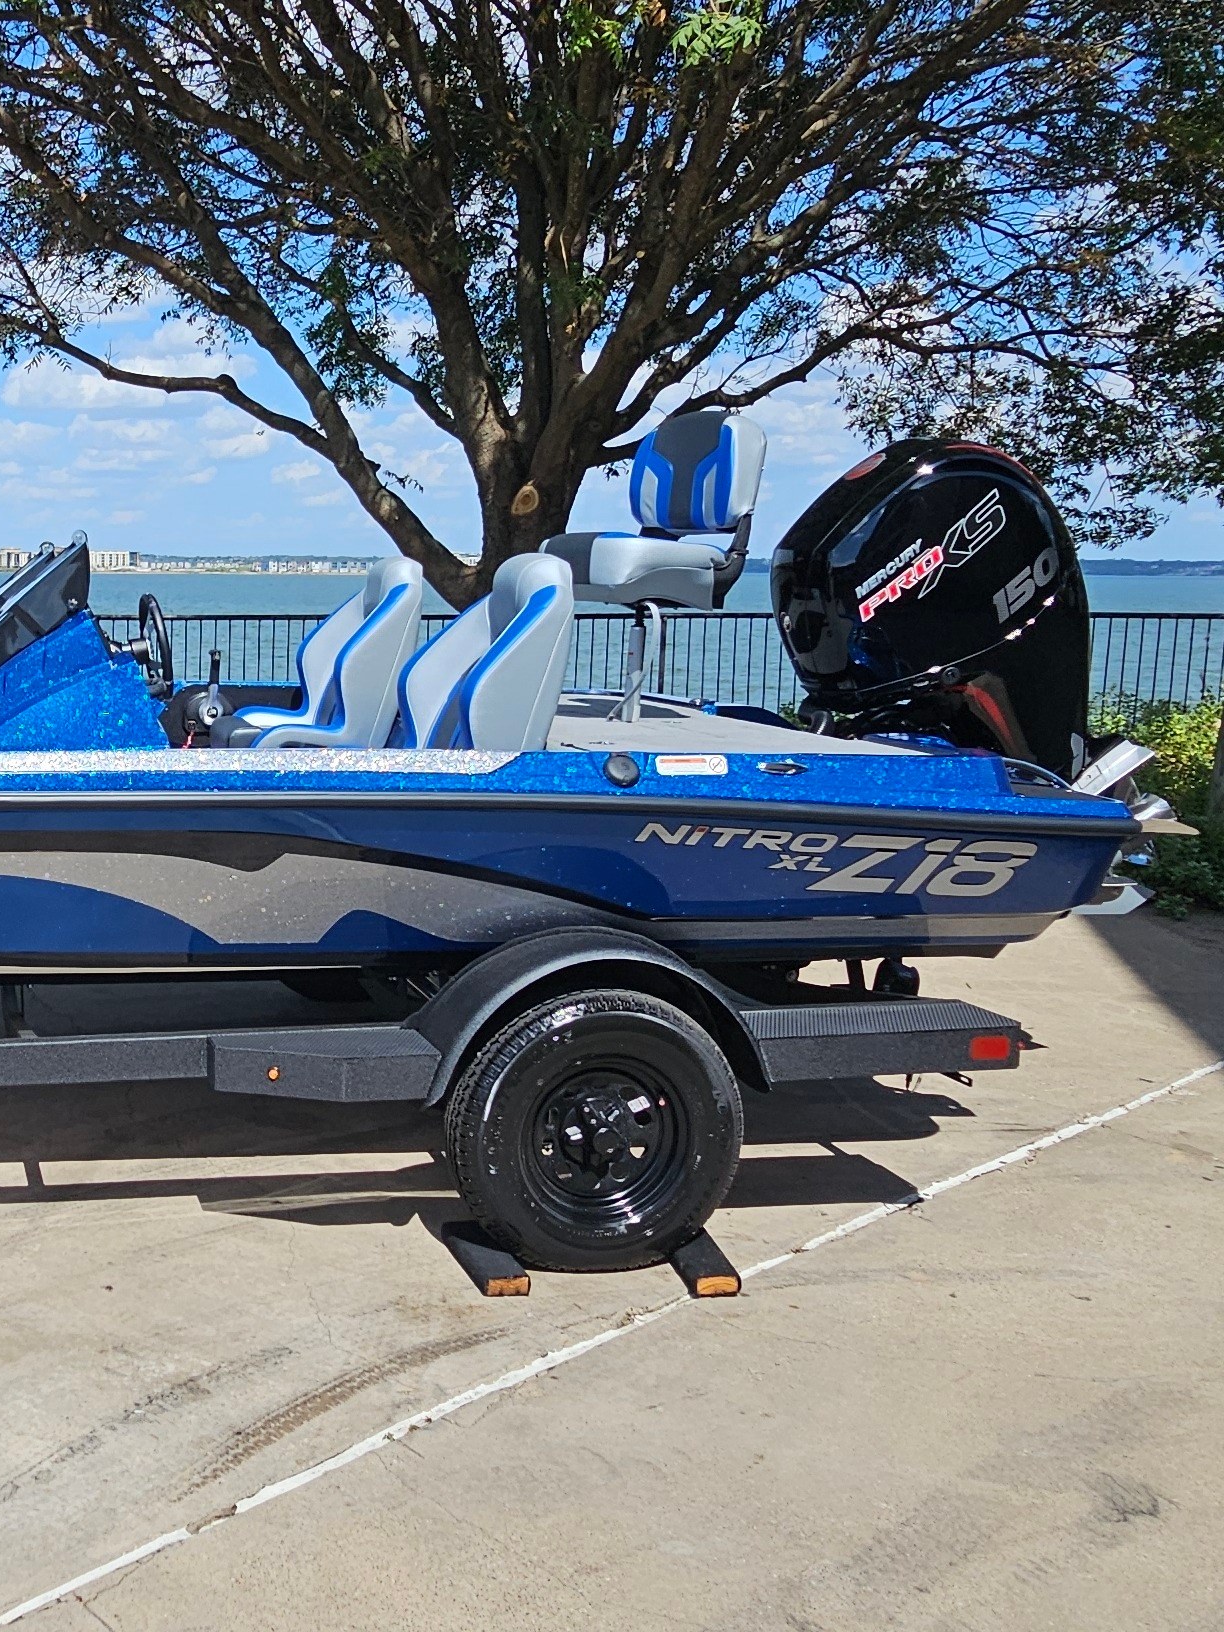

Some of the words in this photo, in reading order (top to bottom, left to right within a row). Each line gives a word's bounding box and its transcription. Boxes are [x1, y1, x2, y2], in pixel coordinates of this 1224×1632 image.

[855, 538, 923, 600] MERCURY
[992, 547, 1060, 624] 150
[634, 822, 840, 854] NITRO
[805, 834, 1039, 897] Z18
[768, 853, 833, 873] XL
